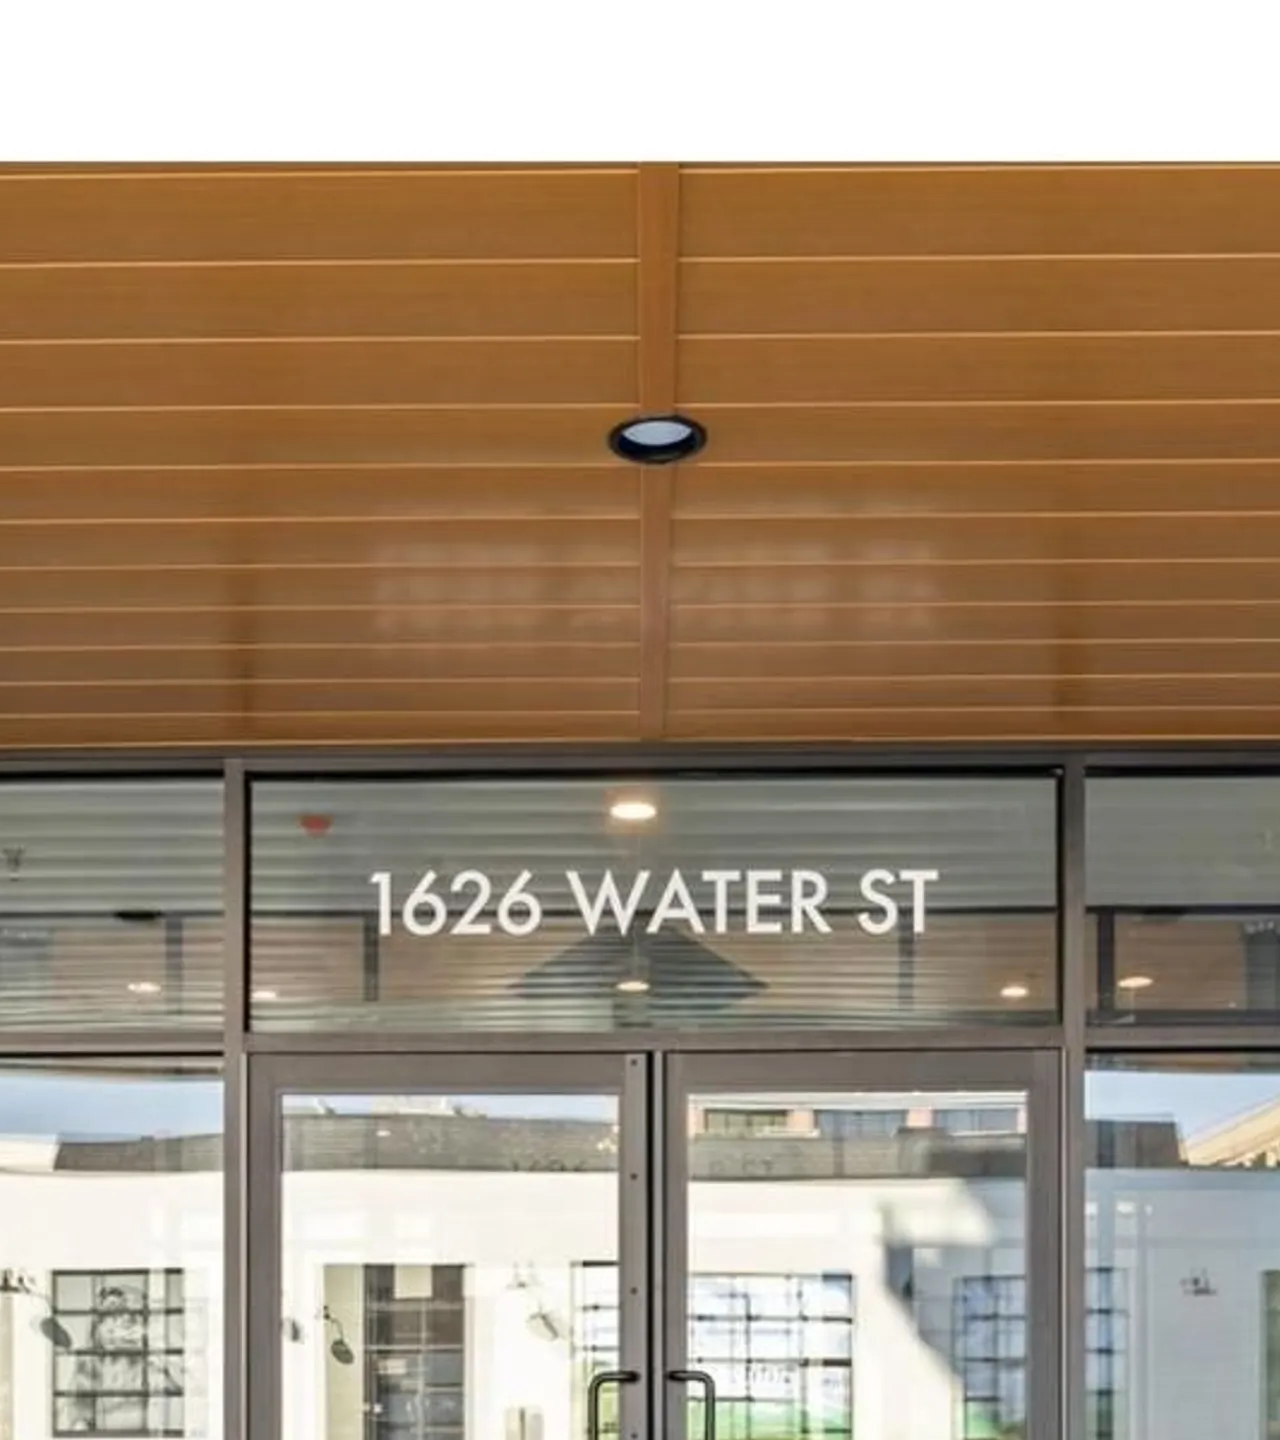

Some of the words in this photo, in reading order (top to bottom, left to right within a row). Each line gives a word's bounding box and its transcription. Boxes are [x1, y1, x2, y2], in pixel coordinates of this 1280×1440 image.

[369, 869, 542, 936] 1626
[565, 867, 833, 936] WATER
[856, 867, 940, 934] ST
